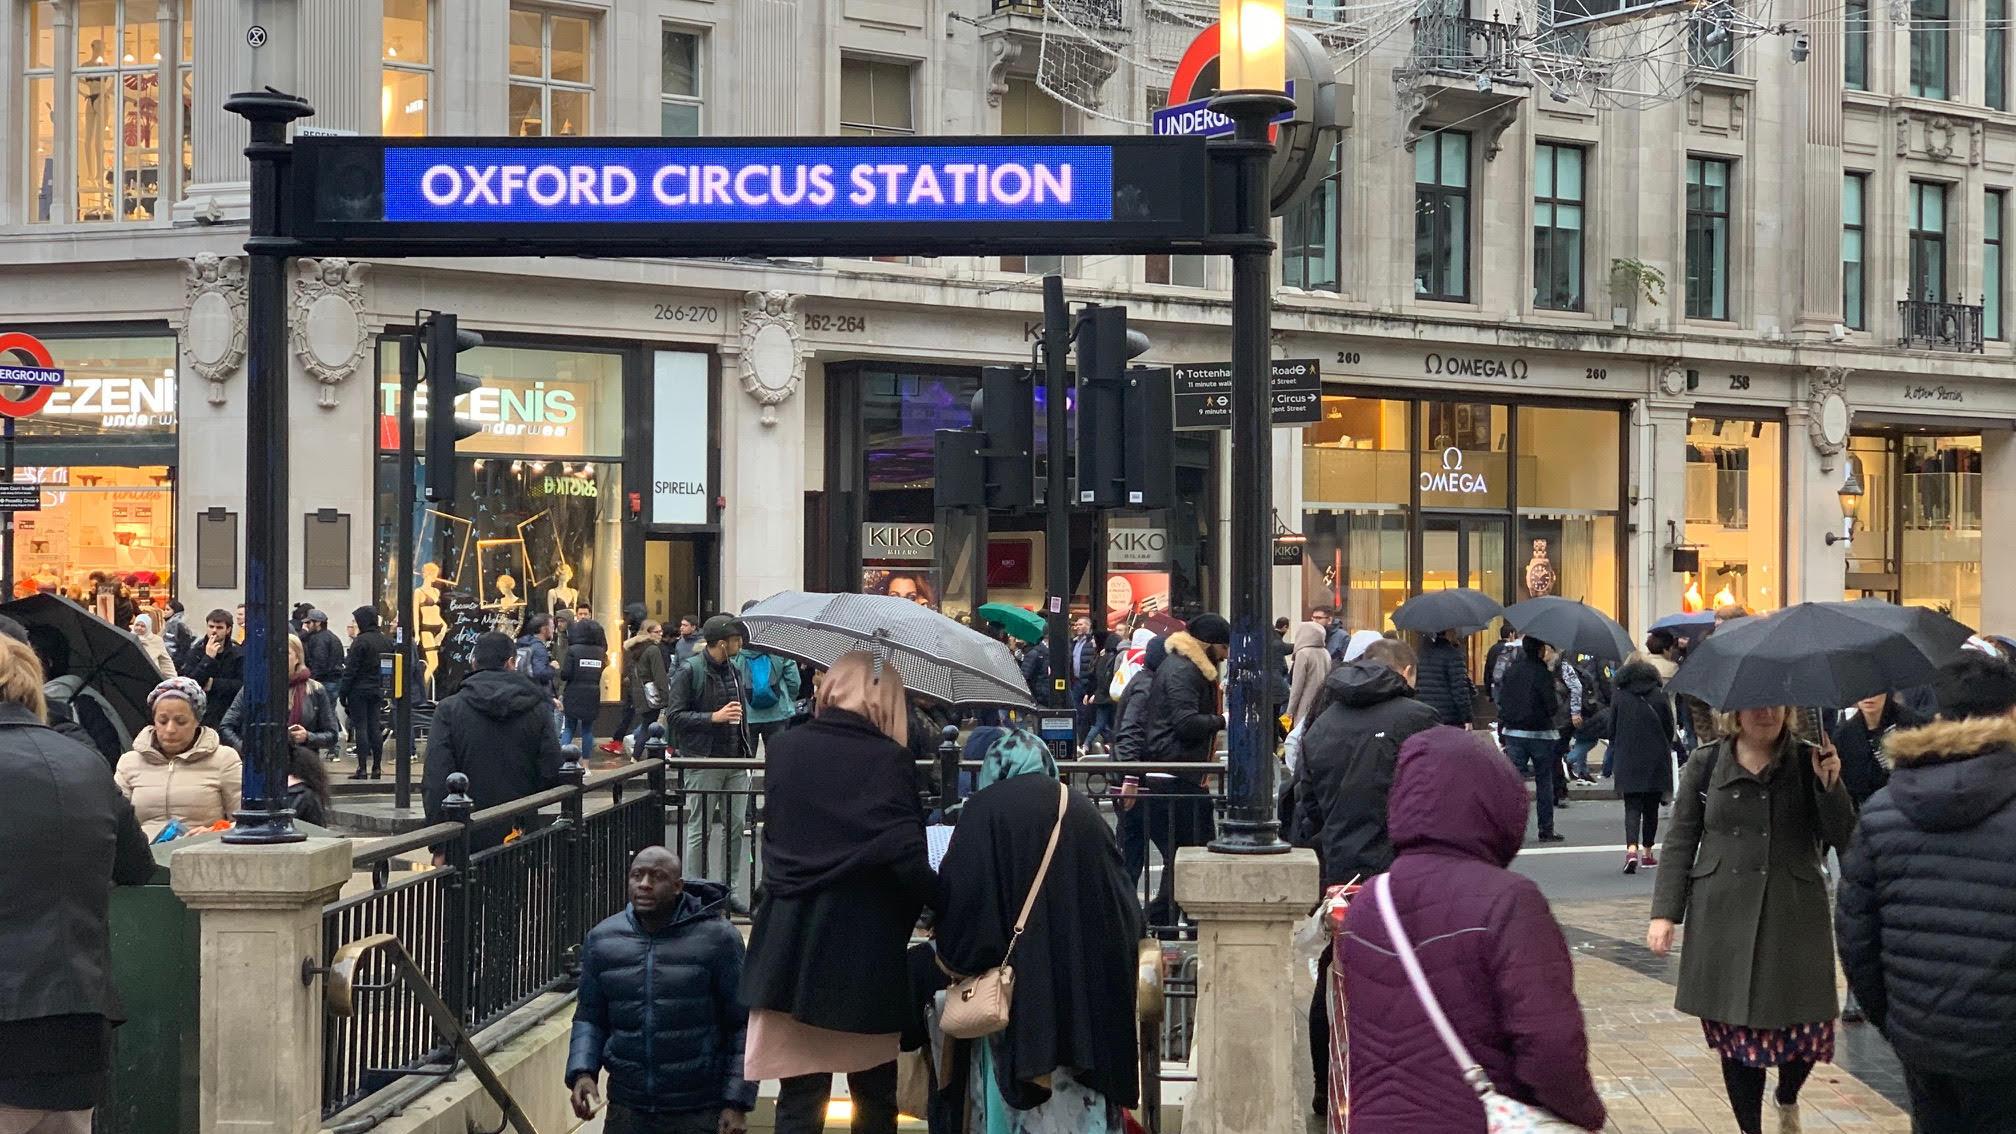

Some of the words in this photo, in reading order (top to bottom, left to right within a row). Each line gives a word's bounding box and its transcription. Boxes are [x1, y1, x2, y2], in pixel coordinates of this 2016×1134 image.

[1158, 108, 1235, 136] UNDERG
[421, 163, 637, 206] OXFORD
[651, 163, 835, 207] CIRCUS
[849, 162, 1073, 206] STATION
[654, 303, 718, 323] 266-270
[804, 313, 866, 332] 262-264
[1336, 351, 1361, 365] 260
[1272, 365, 1295, 376] Road
[1446, 357, 1508, 378] OMEGA
[1585, 367, 1607, 380] 260
[0, 368, 61, 383] ERGROUND
[1277, 377, 1297, 385] Street
[1729, 374, 1751, 390] 258
[1277, 393, 1307, 404] Circus
[1204, 407, 1227, 415] minute
[1271, 406, 1285, 414] gent
[1286, 405, 1307, 413] Street
[654, 480, 705, 495] SPIRELLA
[1420, 471, 1488, 493] OMEGA
[868, 526, 934, 548] KIKO
[1107, 532, 1166, 551] KIKO
[1274, 545, 1300, 556] KIKO
